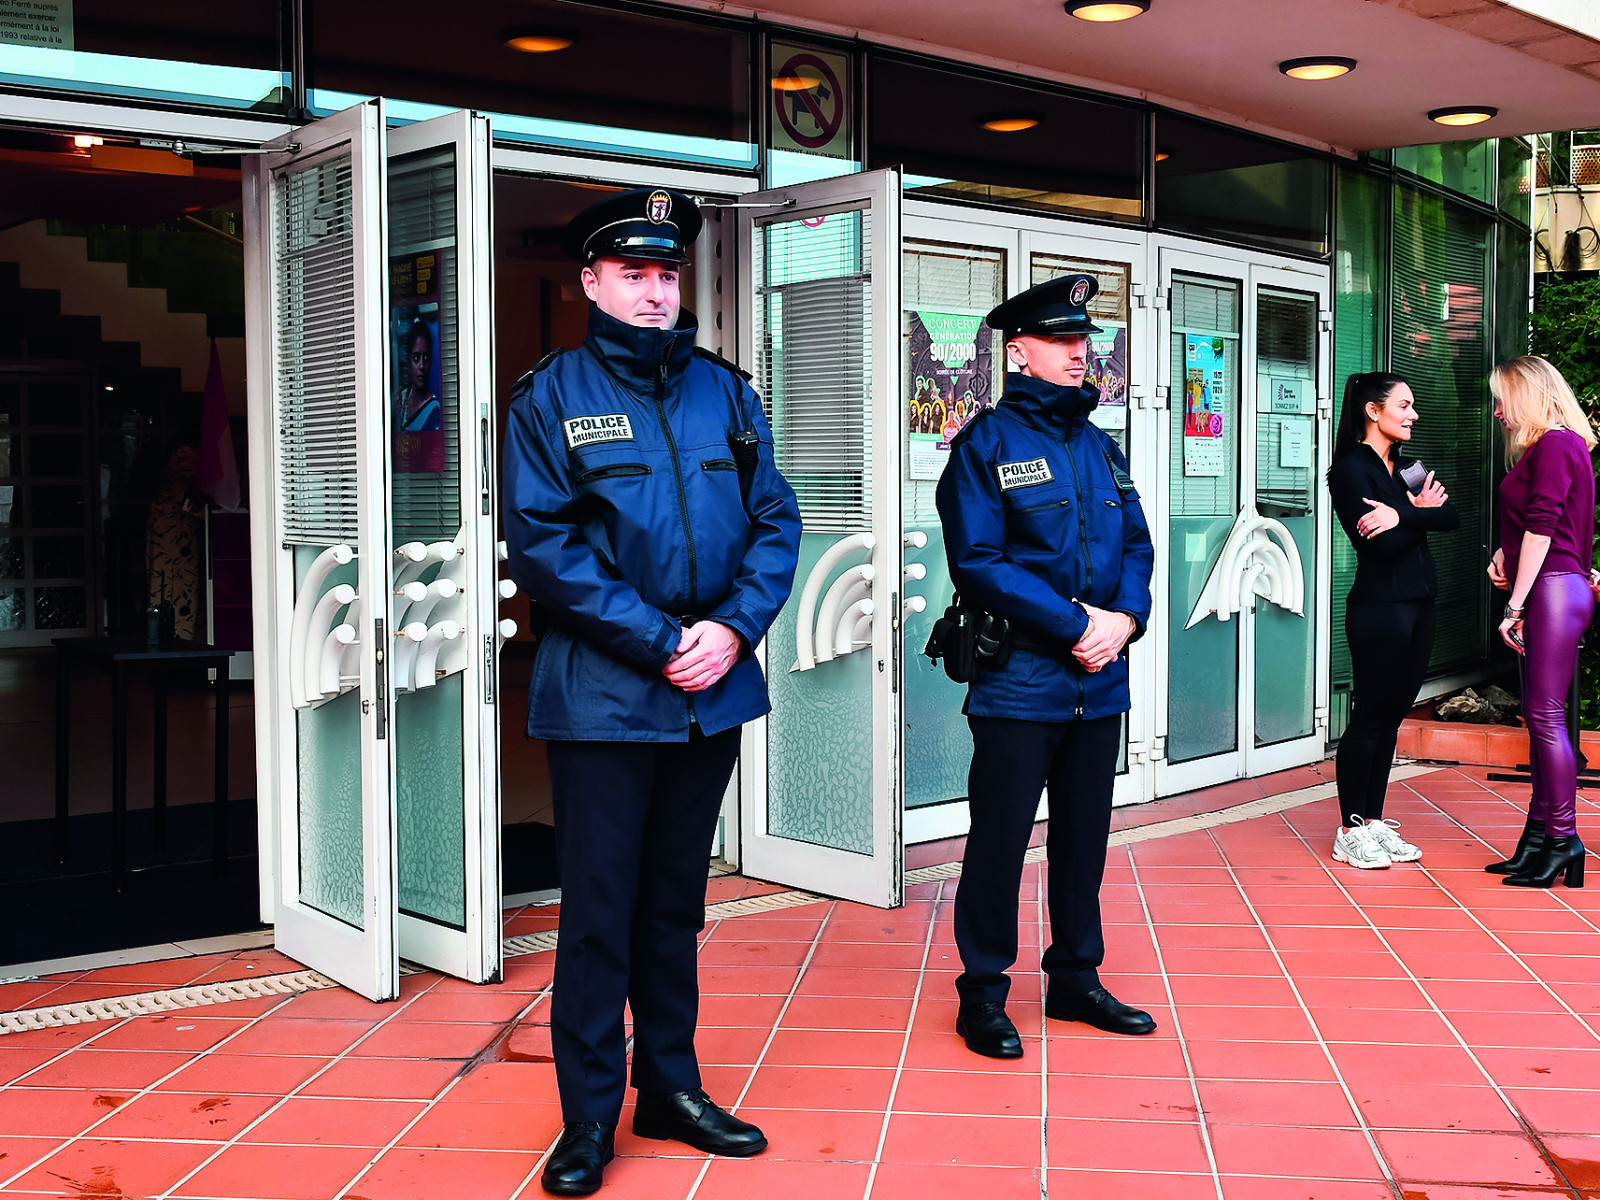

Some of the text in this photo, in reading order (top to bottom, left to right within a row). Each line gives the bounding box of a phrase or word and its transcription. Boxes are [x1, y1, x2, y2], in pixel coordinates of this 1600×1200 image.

[28, 13, 56, 21] exercer
[42, 24, 49, 32] la
[50, 25, 60, 33] loi
[0, 31, 18, 39] 1993
[20, 33, 47, 43] relative
[55, 36, 63, 44] la
[928, 318, 976, 329] CONCERT
[930, 342, 976, 362] 90/2000
[569, 416, 627, 434] POLICE
[572, 428, 629, 444] MUNICIPALE
[1001, 461, 1045, 477] POLICE
[1004, 471, 1048, 487] MUNICIPALE
